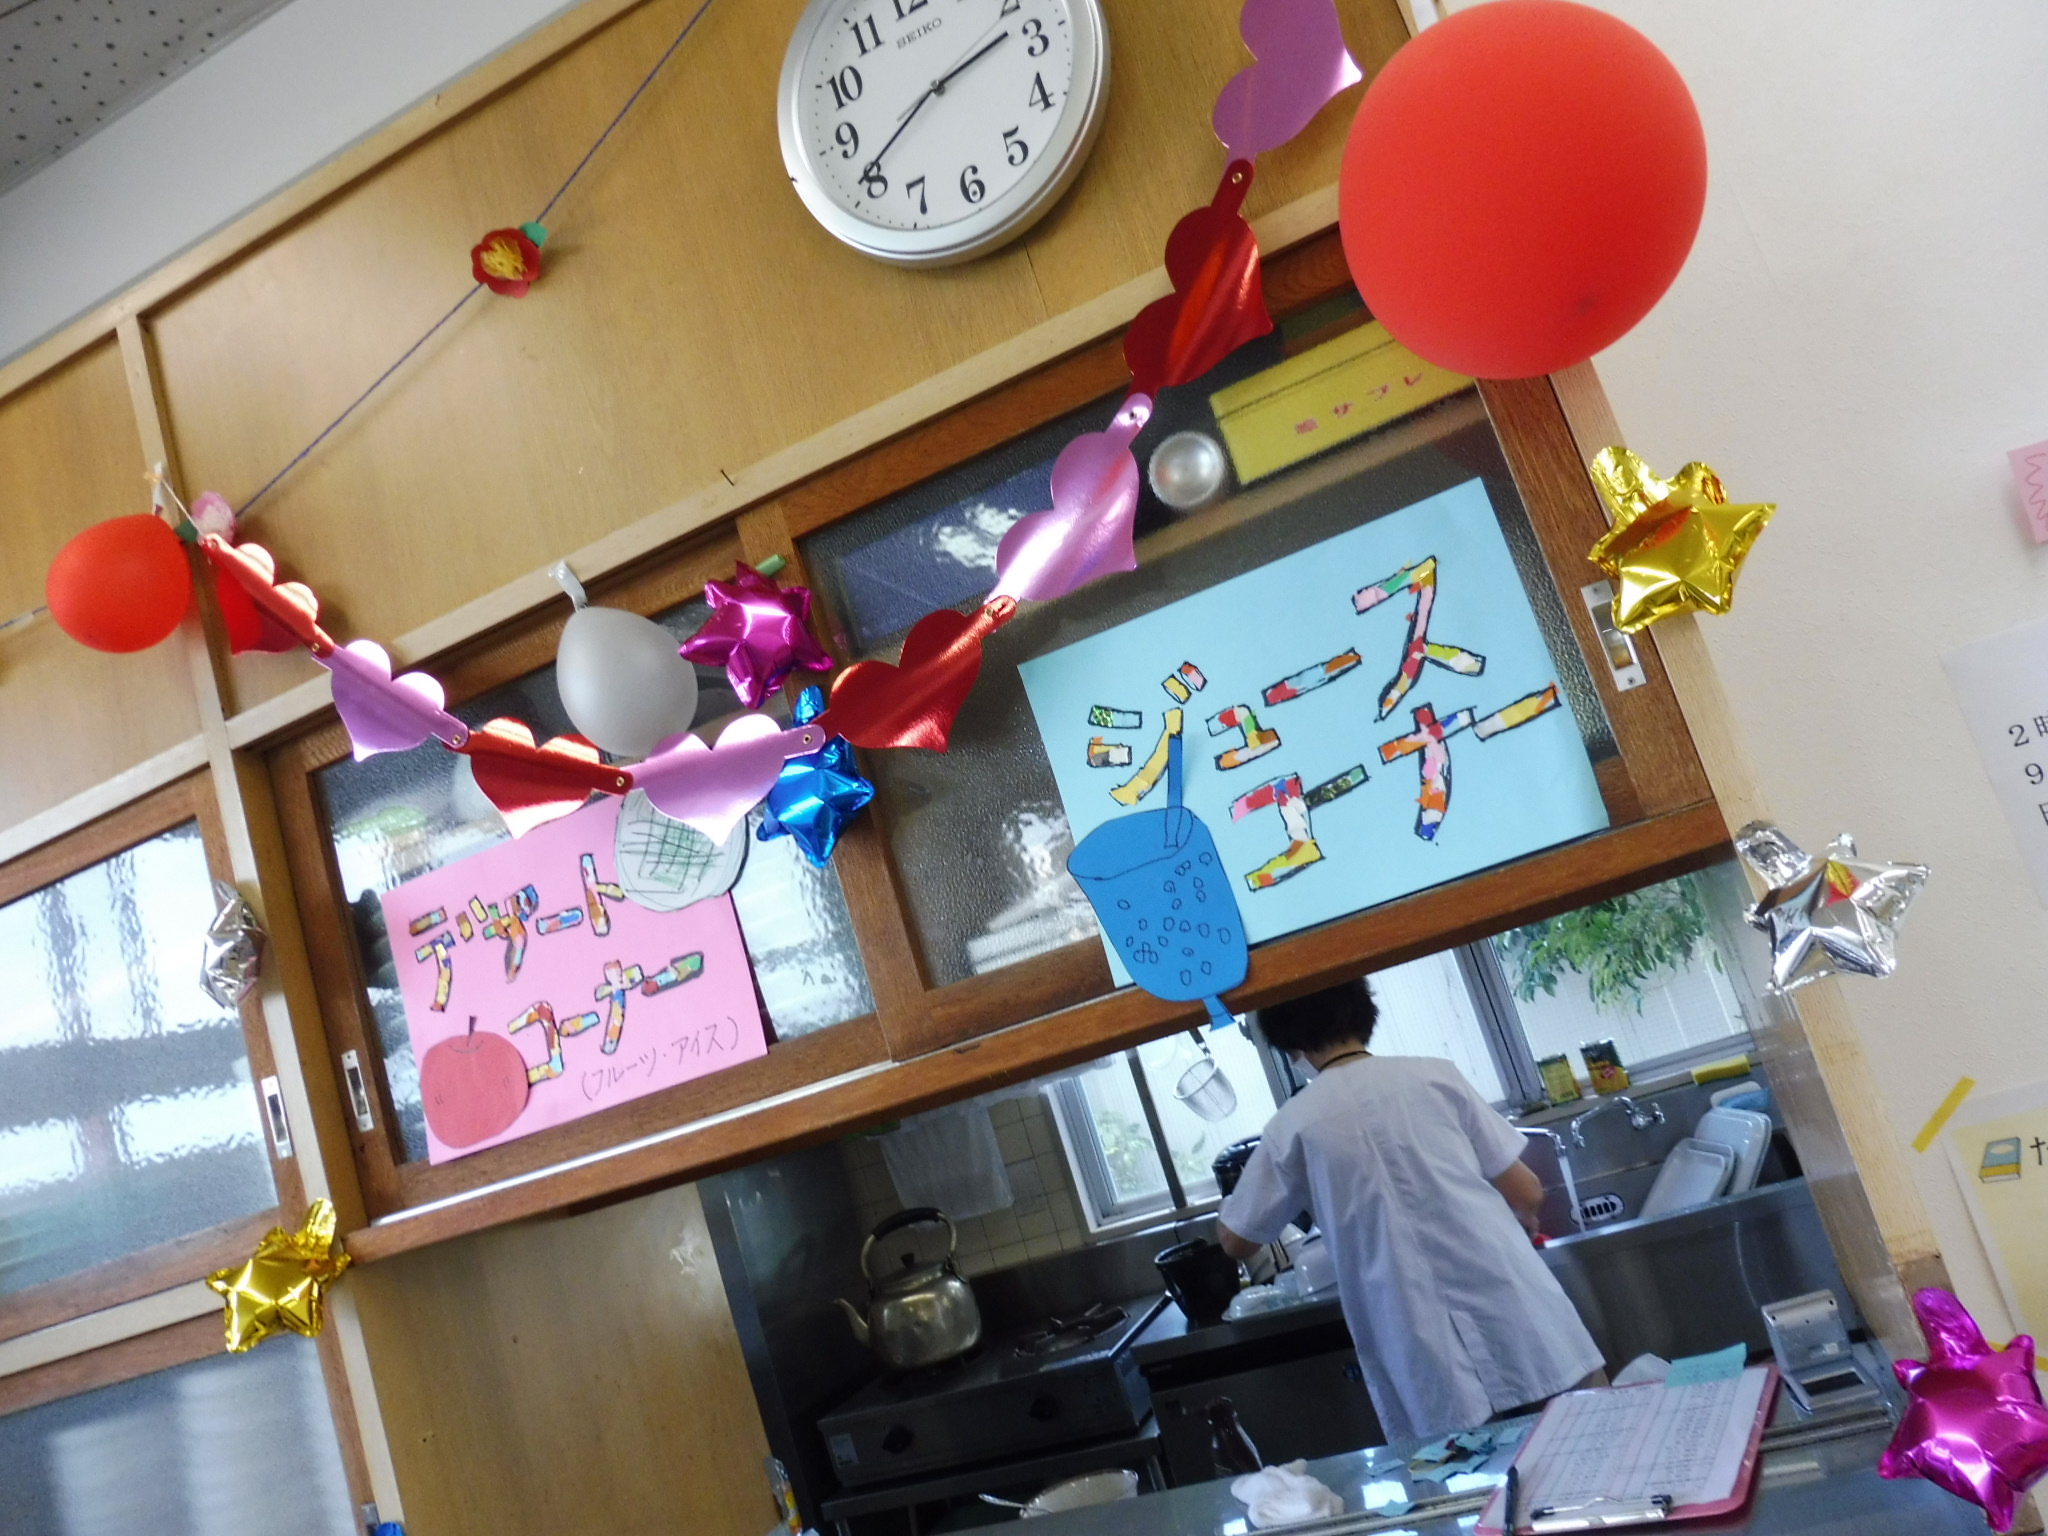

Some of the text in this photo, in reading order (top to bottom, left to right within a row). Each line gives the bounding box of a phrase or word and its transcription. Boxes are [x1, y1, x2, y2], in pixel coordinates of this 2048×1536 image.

[849, 14, 886, 57] 11
[896, 17, 942, 49] SEIKO
[1021, 18, 1049, 57] 3
[826, 65, 864, 111] 10
[1028, 72, 1055, 113] 4
[835, 121, 860, 159] 9
[1002, 126, 1029, 166] 5
[863, 161, 889, 199] 8
[906, 176, 928, 215] 7
[959, 165, 986, 204] 6
[1086, 554, 1488, 810] ジュース
[409, 853, 626, 1013] デザート
[508, 951, 705, 1086] コーナー
